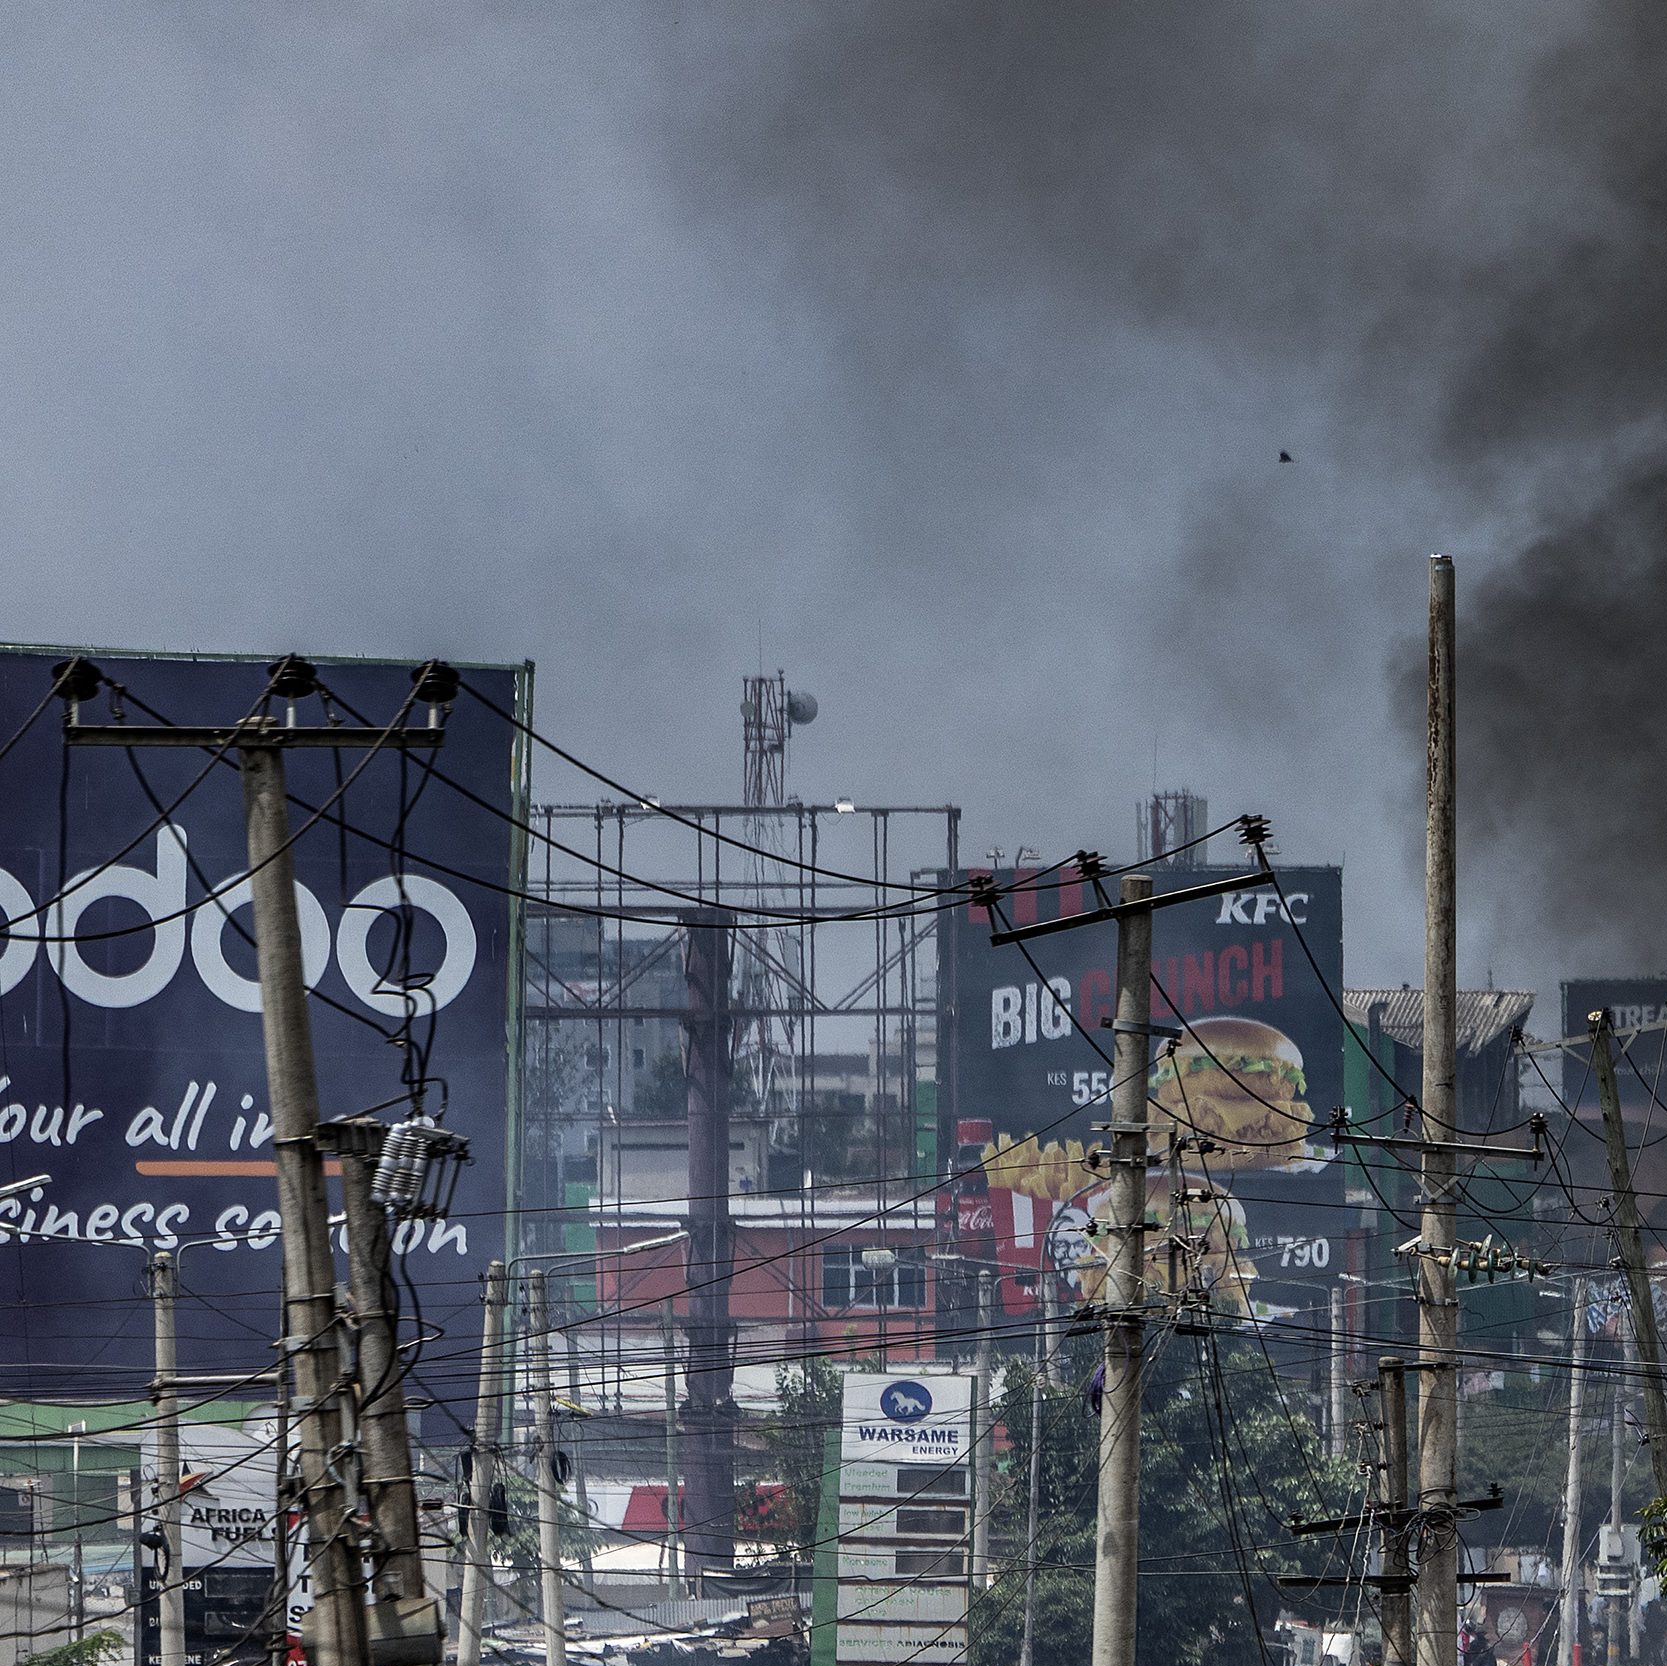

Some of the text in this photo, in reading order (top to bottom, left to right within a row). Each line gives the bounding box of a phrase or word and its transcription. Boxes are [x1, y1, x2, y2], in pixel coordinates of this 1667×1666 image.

[0, 822, 477, 1018] doo
[1216, 893, 1309, 925] KFC
[992, 938, 1283, 1049] BIG CUNCH
[1047, 1072, 1067, 1086] KES
[0, 1076, 103, 1147] our
[125, 1080, 217, 1151] all
[1255, 1235, 1330, 1268] KES 790
[859, 1426, 959, 1444] WARSAME
[912, 1446, 959, 1456] ENERGY
[191, 1508, 266, 1523] AFRICA
